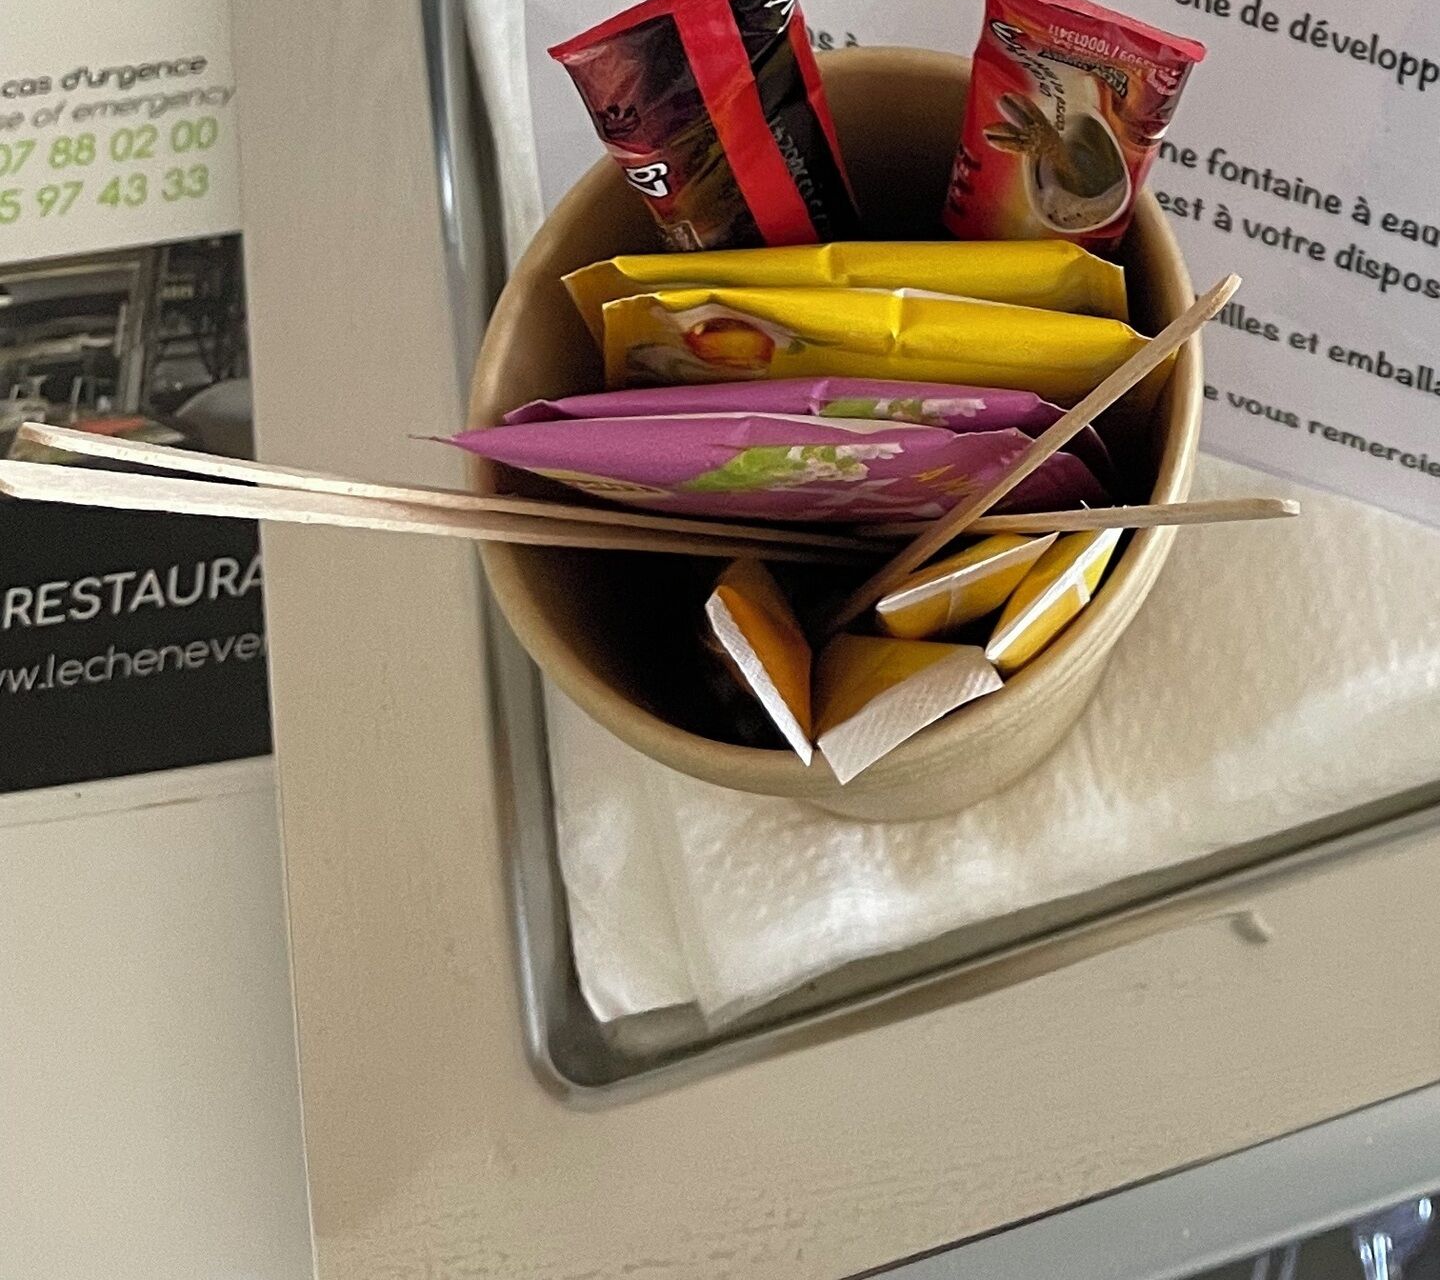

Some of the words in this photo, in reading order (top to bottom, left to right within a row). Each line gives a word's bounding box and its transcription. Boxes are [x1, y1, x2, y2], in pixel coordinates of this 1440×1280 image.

[48, 131, 97, 171] 88
[109, 123, 159, 162] 02
[170, 115, 219, 153] 00
[36, 180, 86, 218] 97
[97, 171, 148, 208] 43
[162, 163, 210, 203] 33
[1207, 146, 1343, 215] fontaine
[1351, 195, 1373, 227] à
[1381, 210, 1440, 248] eau
[1154, 189, 1206, 222] est
[1213, 203, 1233, 233] à
[1243, 217, 1326, 263] votre
[1210, 301, 1280, 342] illes
[1288, 332, 1319, 355] et
[1227, 390, 1299, 429] vous
